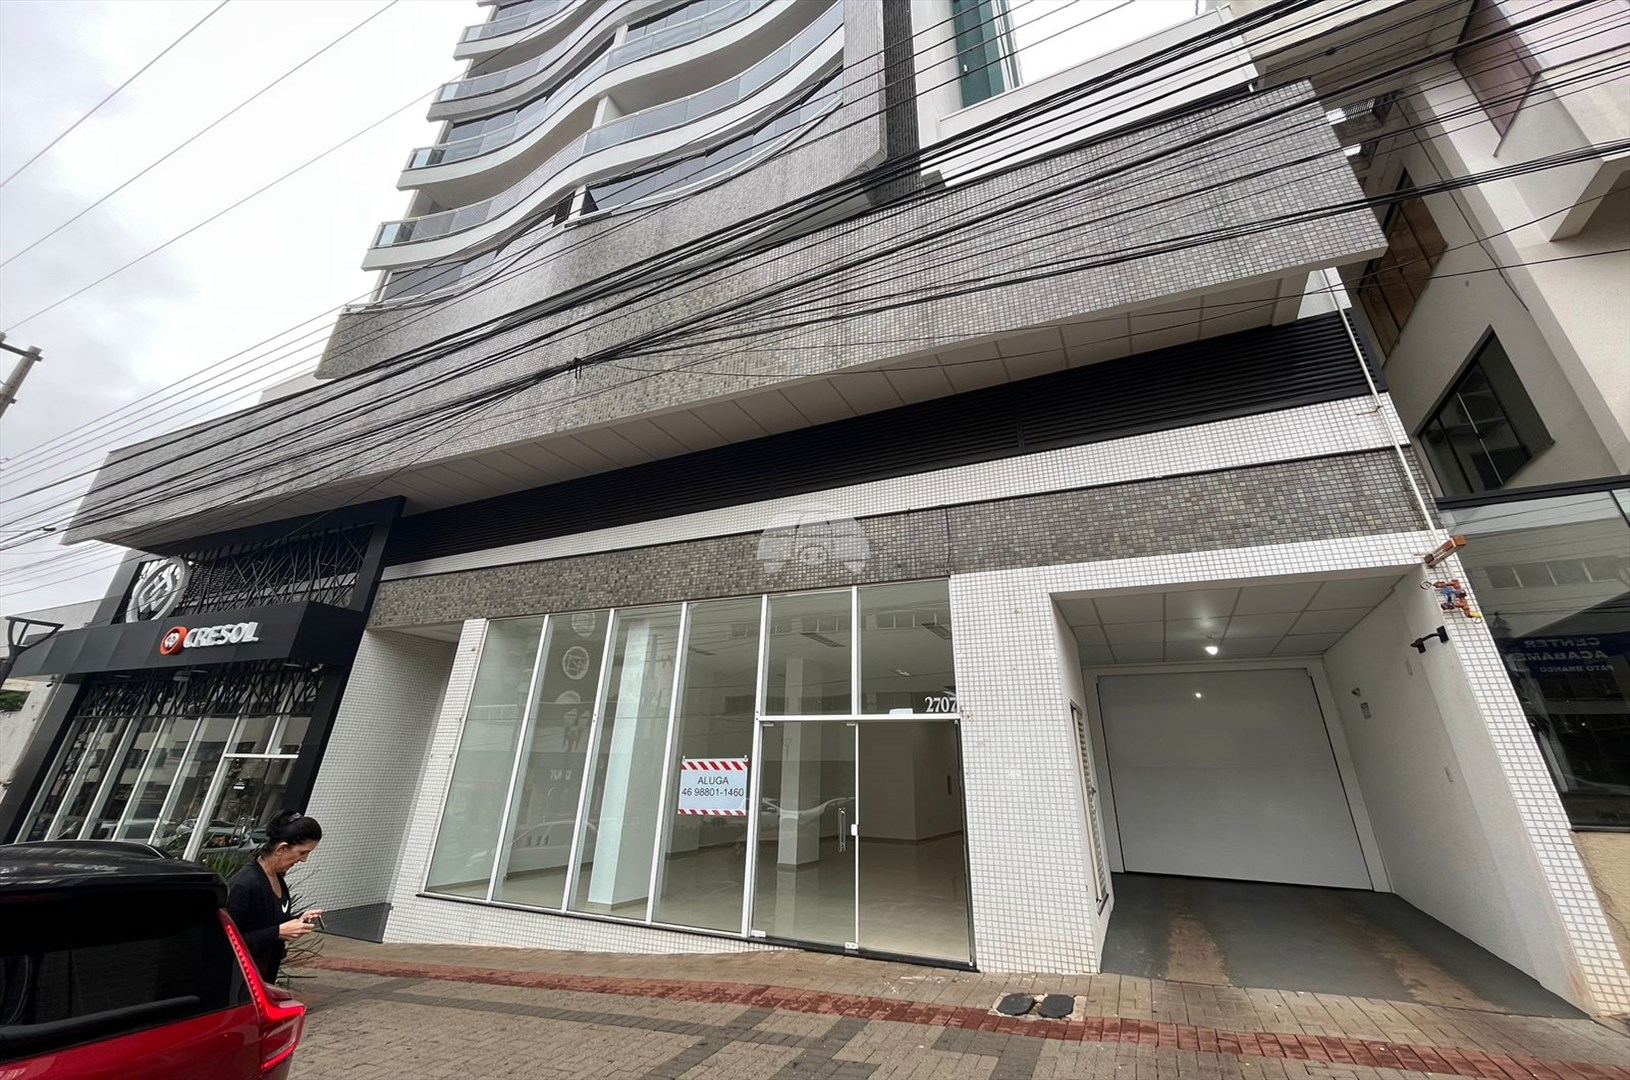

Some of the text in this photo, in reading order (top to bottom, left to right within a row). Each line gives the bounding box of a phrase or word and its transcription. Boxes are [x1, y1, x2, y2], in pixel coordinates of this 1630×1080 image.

[183, 622, 259, 648] CRESOL
[924, 696, 957, 712] 2707
[697, 776, 729, 785] ALUGA
[681, 787, 744, 797] 46 98801-1460
